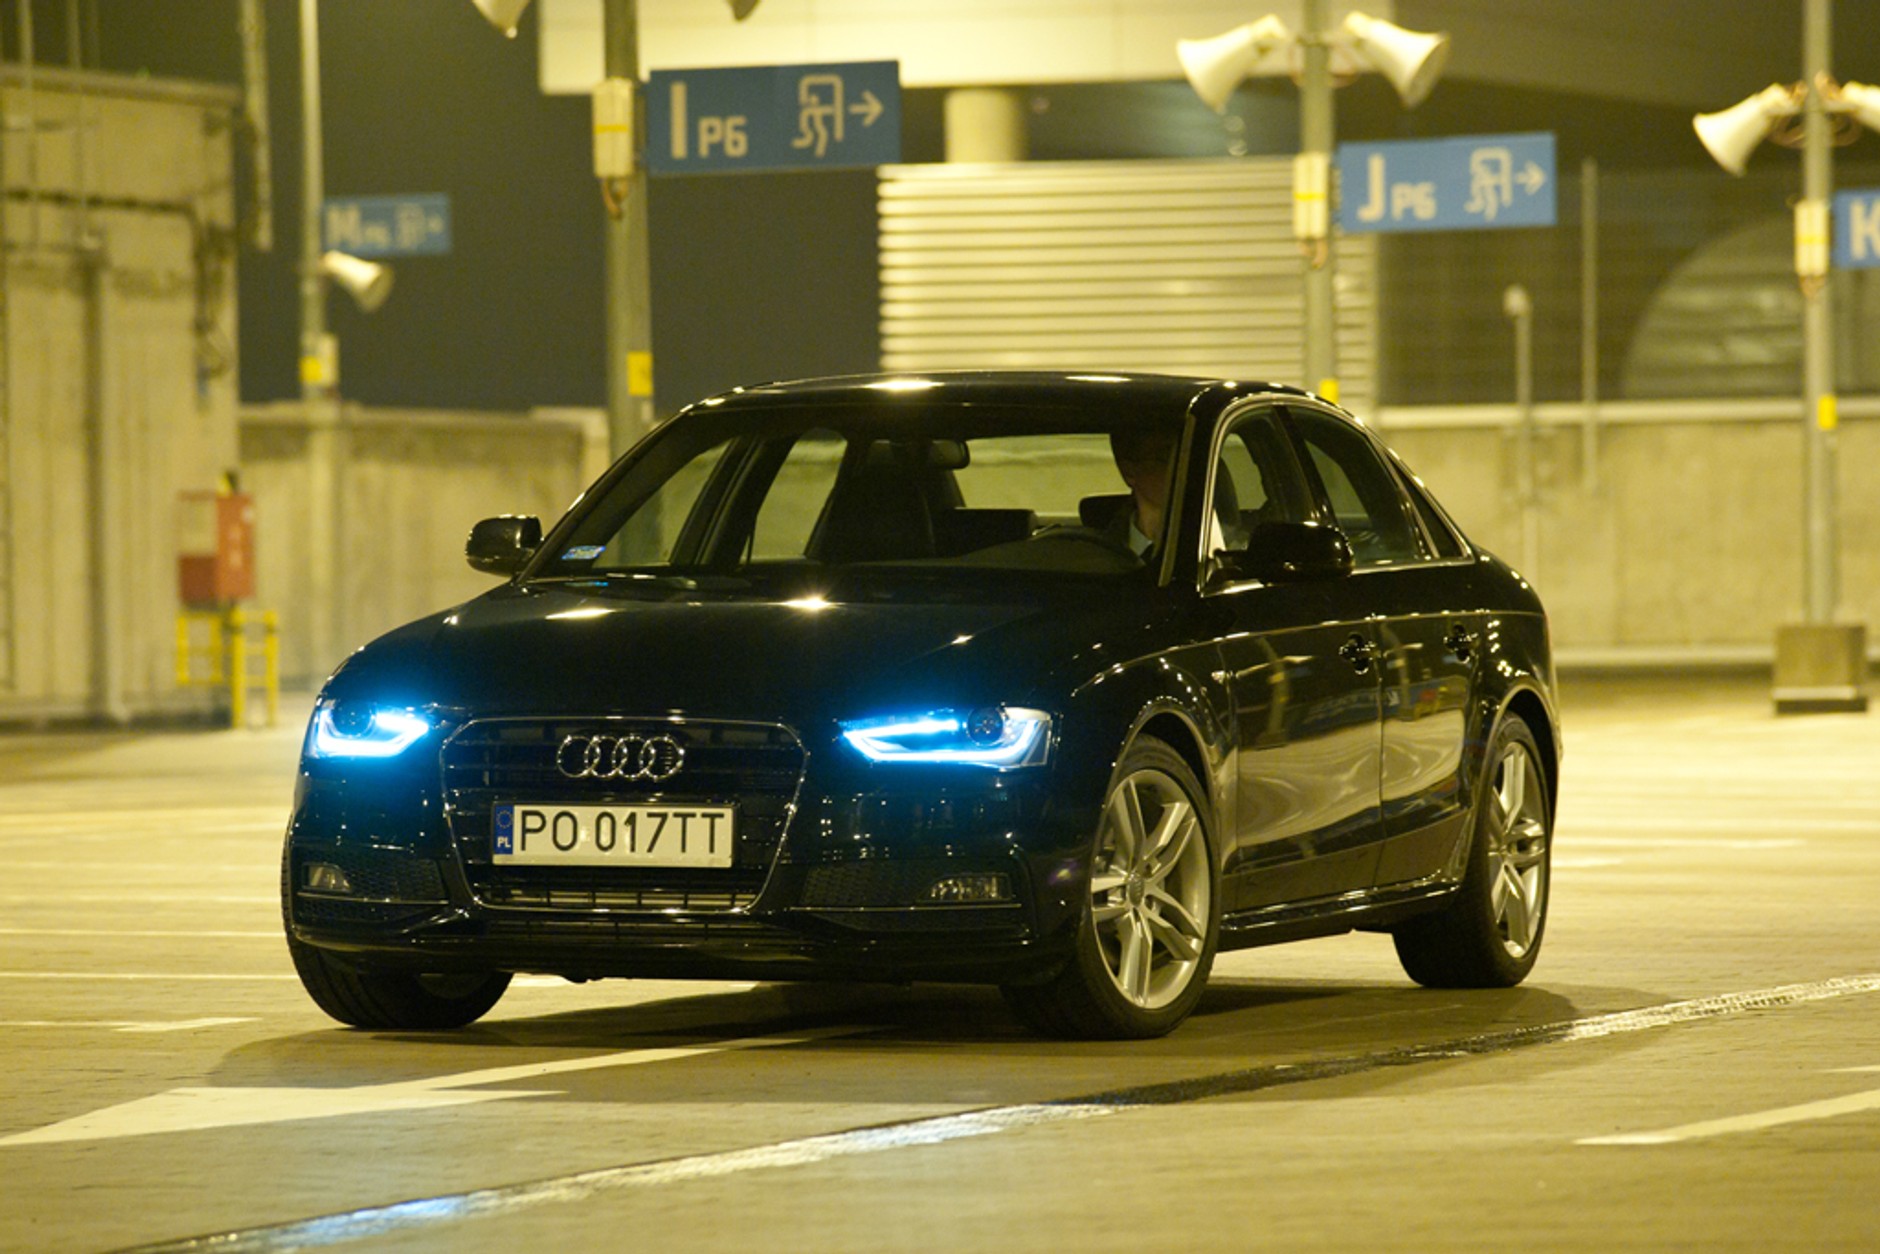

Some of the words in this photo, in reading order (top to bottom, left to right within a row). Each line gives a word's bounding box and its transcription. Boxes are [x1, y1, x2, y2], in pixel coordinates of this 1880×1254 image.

[698, 116, 748, 158] P6
[1357, 153, 1385, 222] J
[1391, 182, 1437, 221] P6
[1850, 199, 1880, 260] K
[497, 836, 511, 848] PL
[521, 810, 578, 852] PO
[595, 811, 725, 854] 017TT
